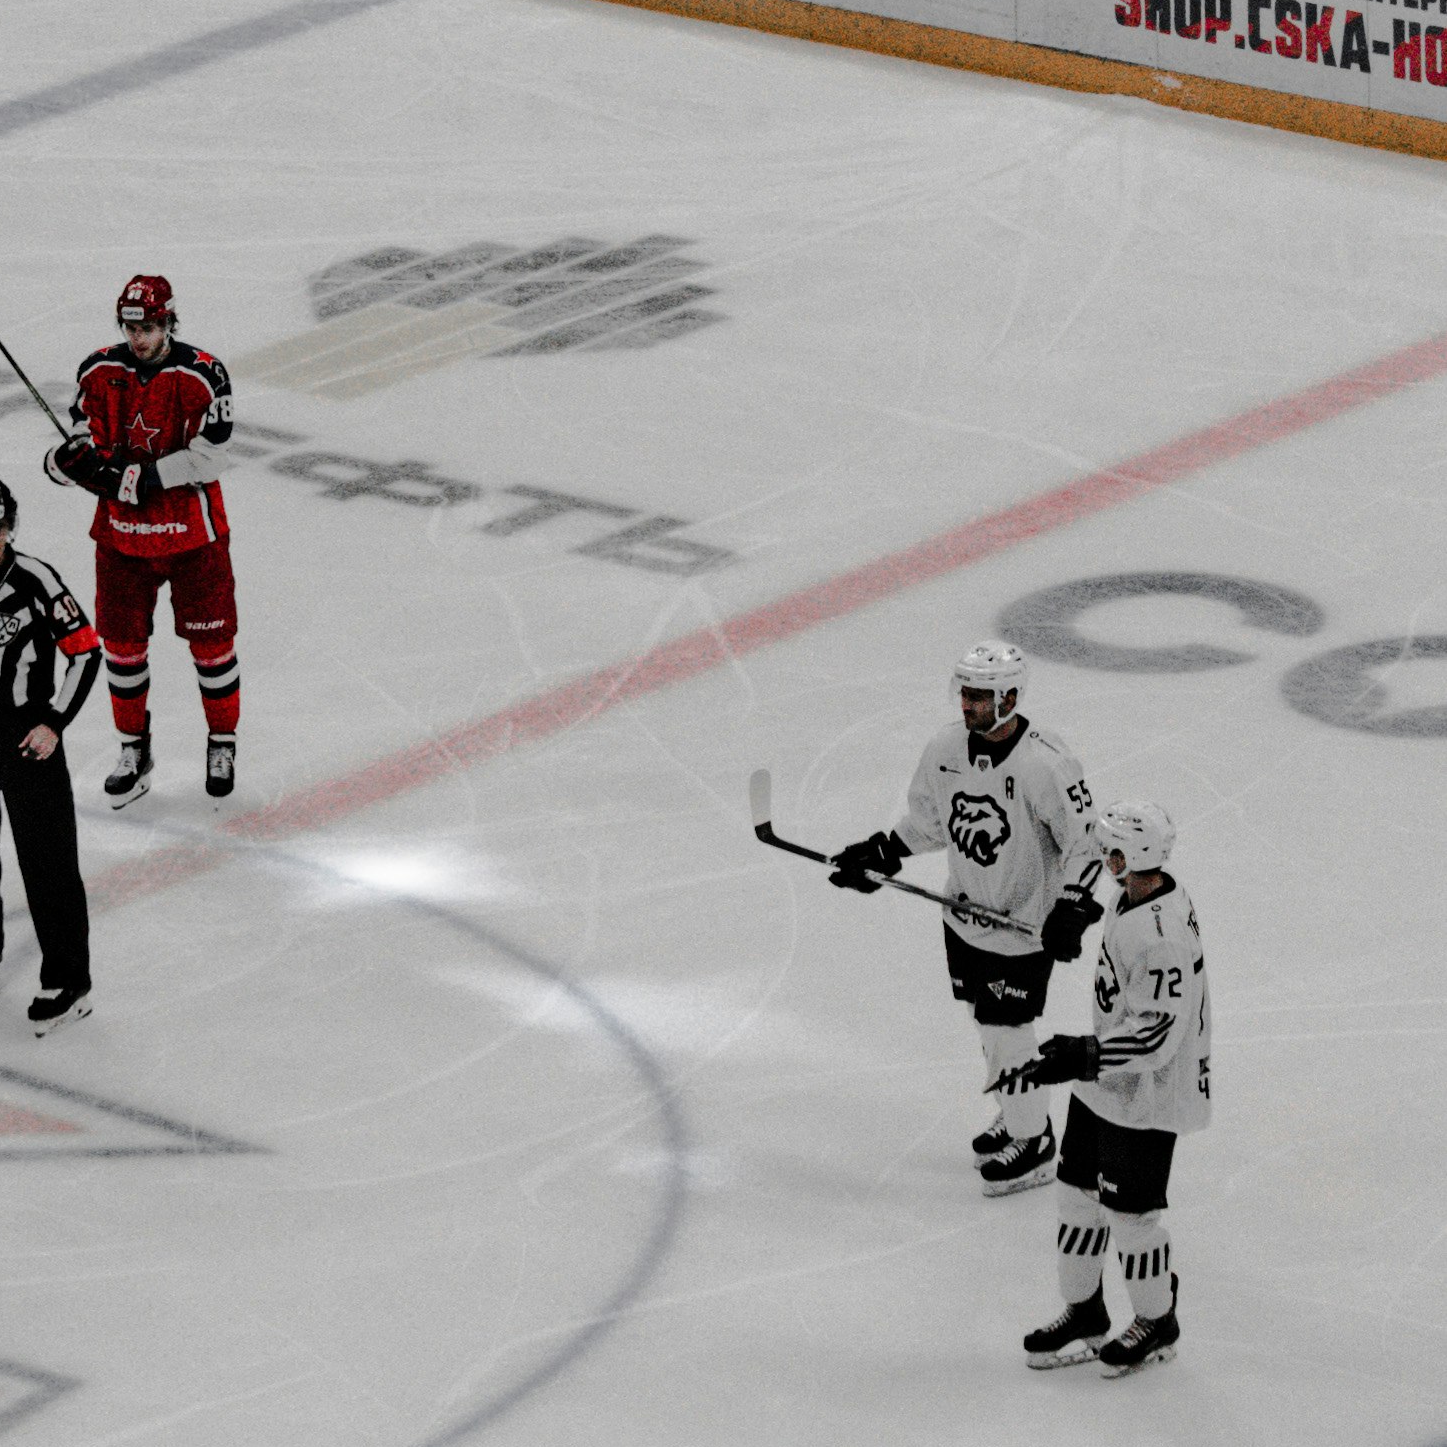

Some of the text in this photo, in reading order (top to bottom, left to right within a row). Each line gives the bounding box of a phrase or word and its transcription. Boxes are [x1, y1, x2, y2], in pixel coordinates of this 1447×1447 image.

[53, 593, 81, 625] 40
[1066, 779, 1093, 814] 55
[1148, 966, 1183, 1001] 72
